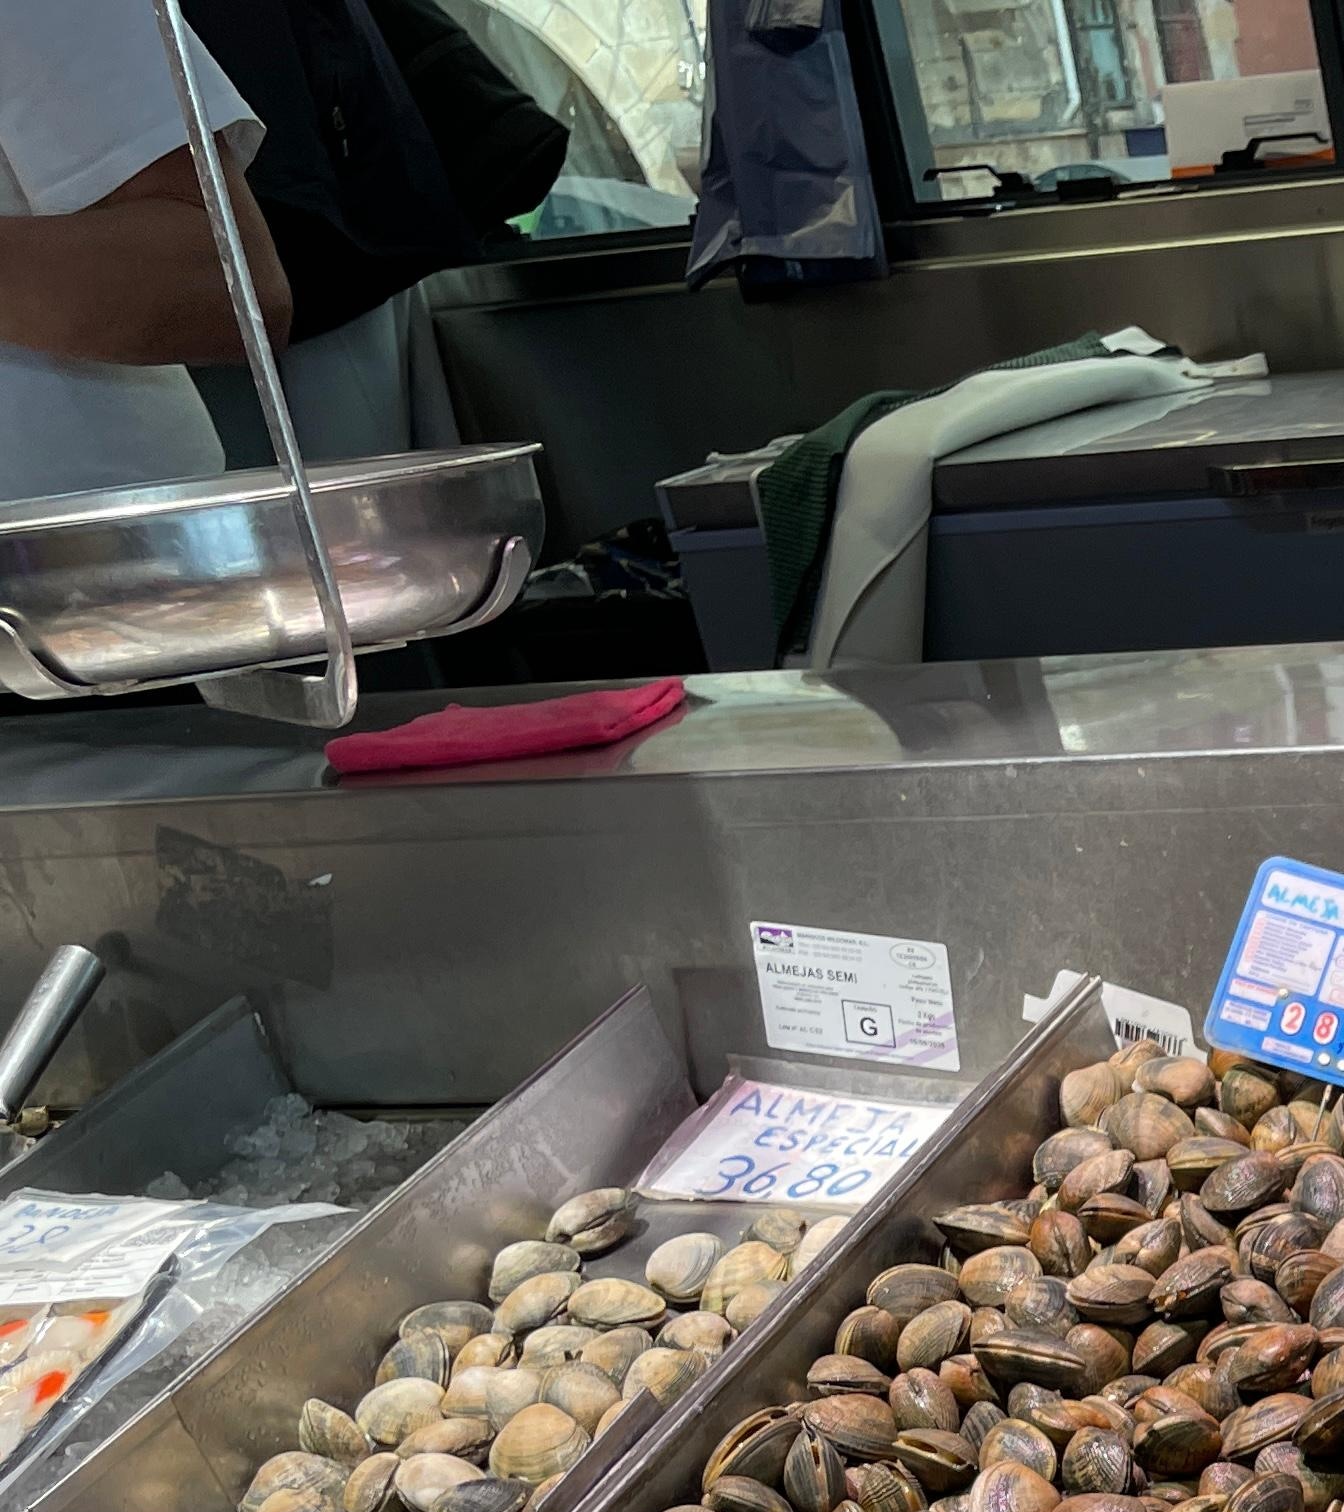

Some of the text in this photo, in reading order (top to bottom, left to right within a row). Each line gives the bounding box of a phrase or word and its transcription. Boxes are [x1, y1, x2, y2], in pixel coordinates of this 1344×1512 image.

[766, 961, 858, 984] ALMEJAS SEMI
[860, 1017, 878, 1037] G
[730, 1088, 913, 1135] ALMEJA
[754, 1126, 918, 1158] ESPECIAL
